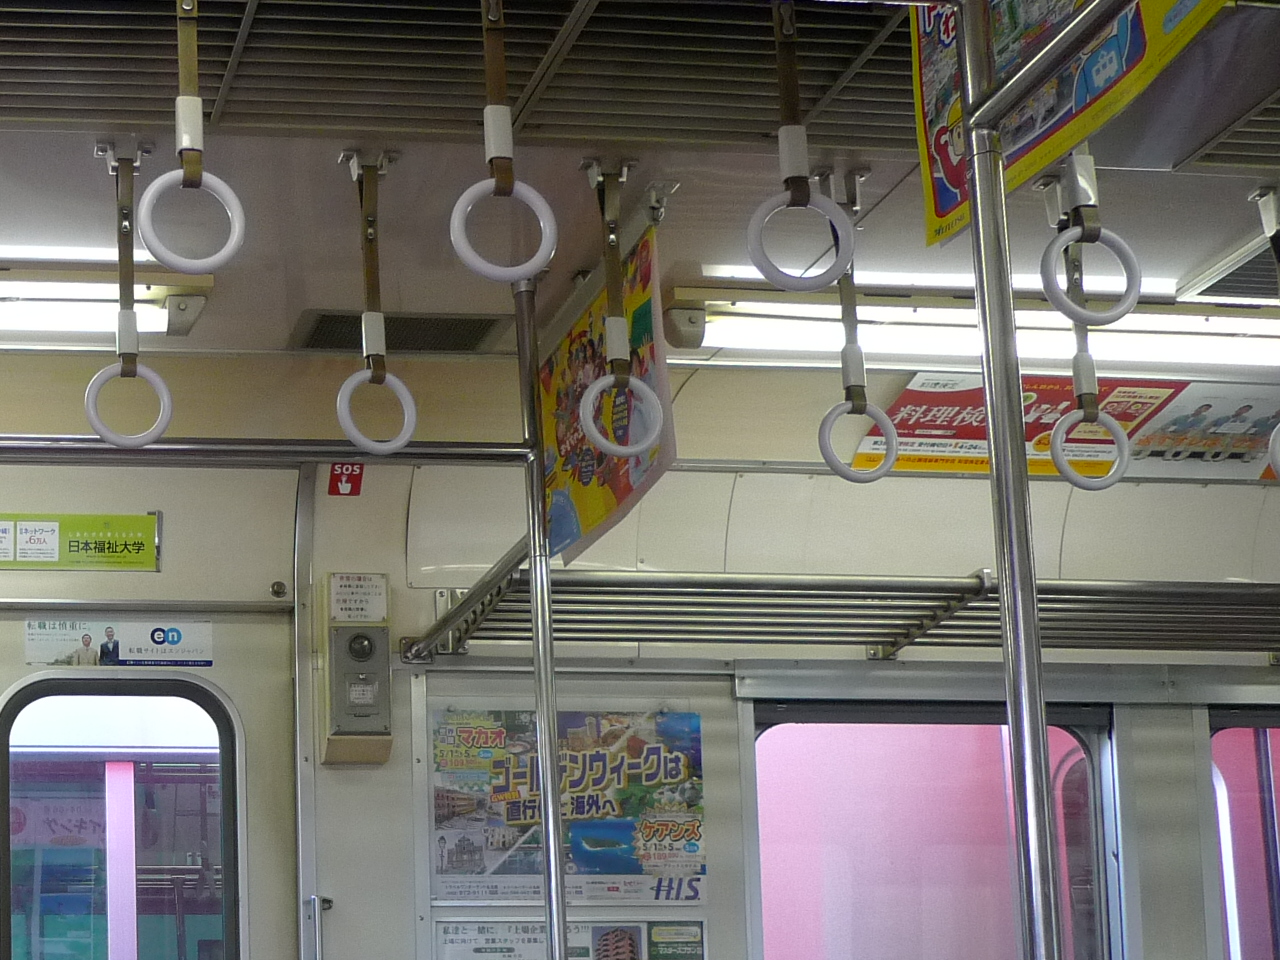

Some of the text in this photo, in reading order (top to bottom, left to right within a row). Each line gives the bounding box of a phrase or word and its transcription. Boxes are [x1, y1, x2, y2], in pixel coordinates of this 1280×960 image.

[891, 404, 987, 426] 料理検
[334, 464, 360, 475] SOS
[68, 540, 145, 554] 日本福祉大学
[152, 630, 180, 643] en
[457, 727, 506, 748] マカオ
[506, 794, 616, 822] 直行海外へ
[642, 820, 702, 842] ケアンズ
[654, 878, 702, 900] H.I.S.
